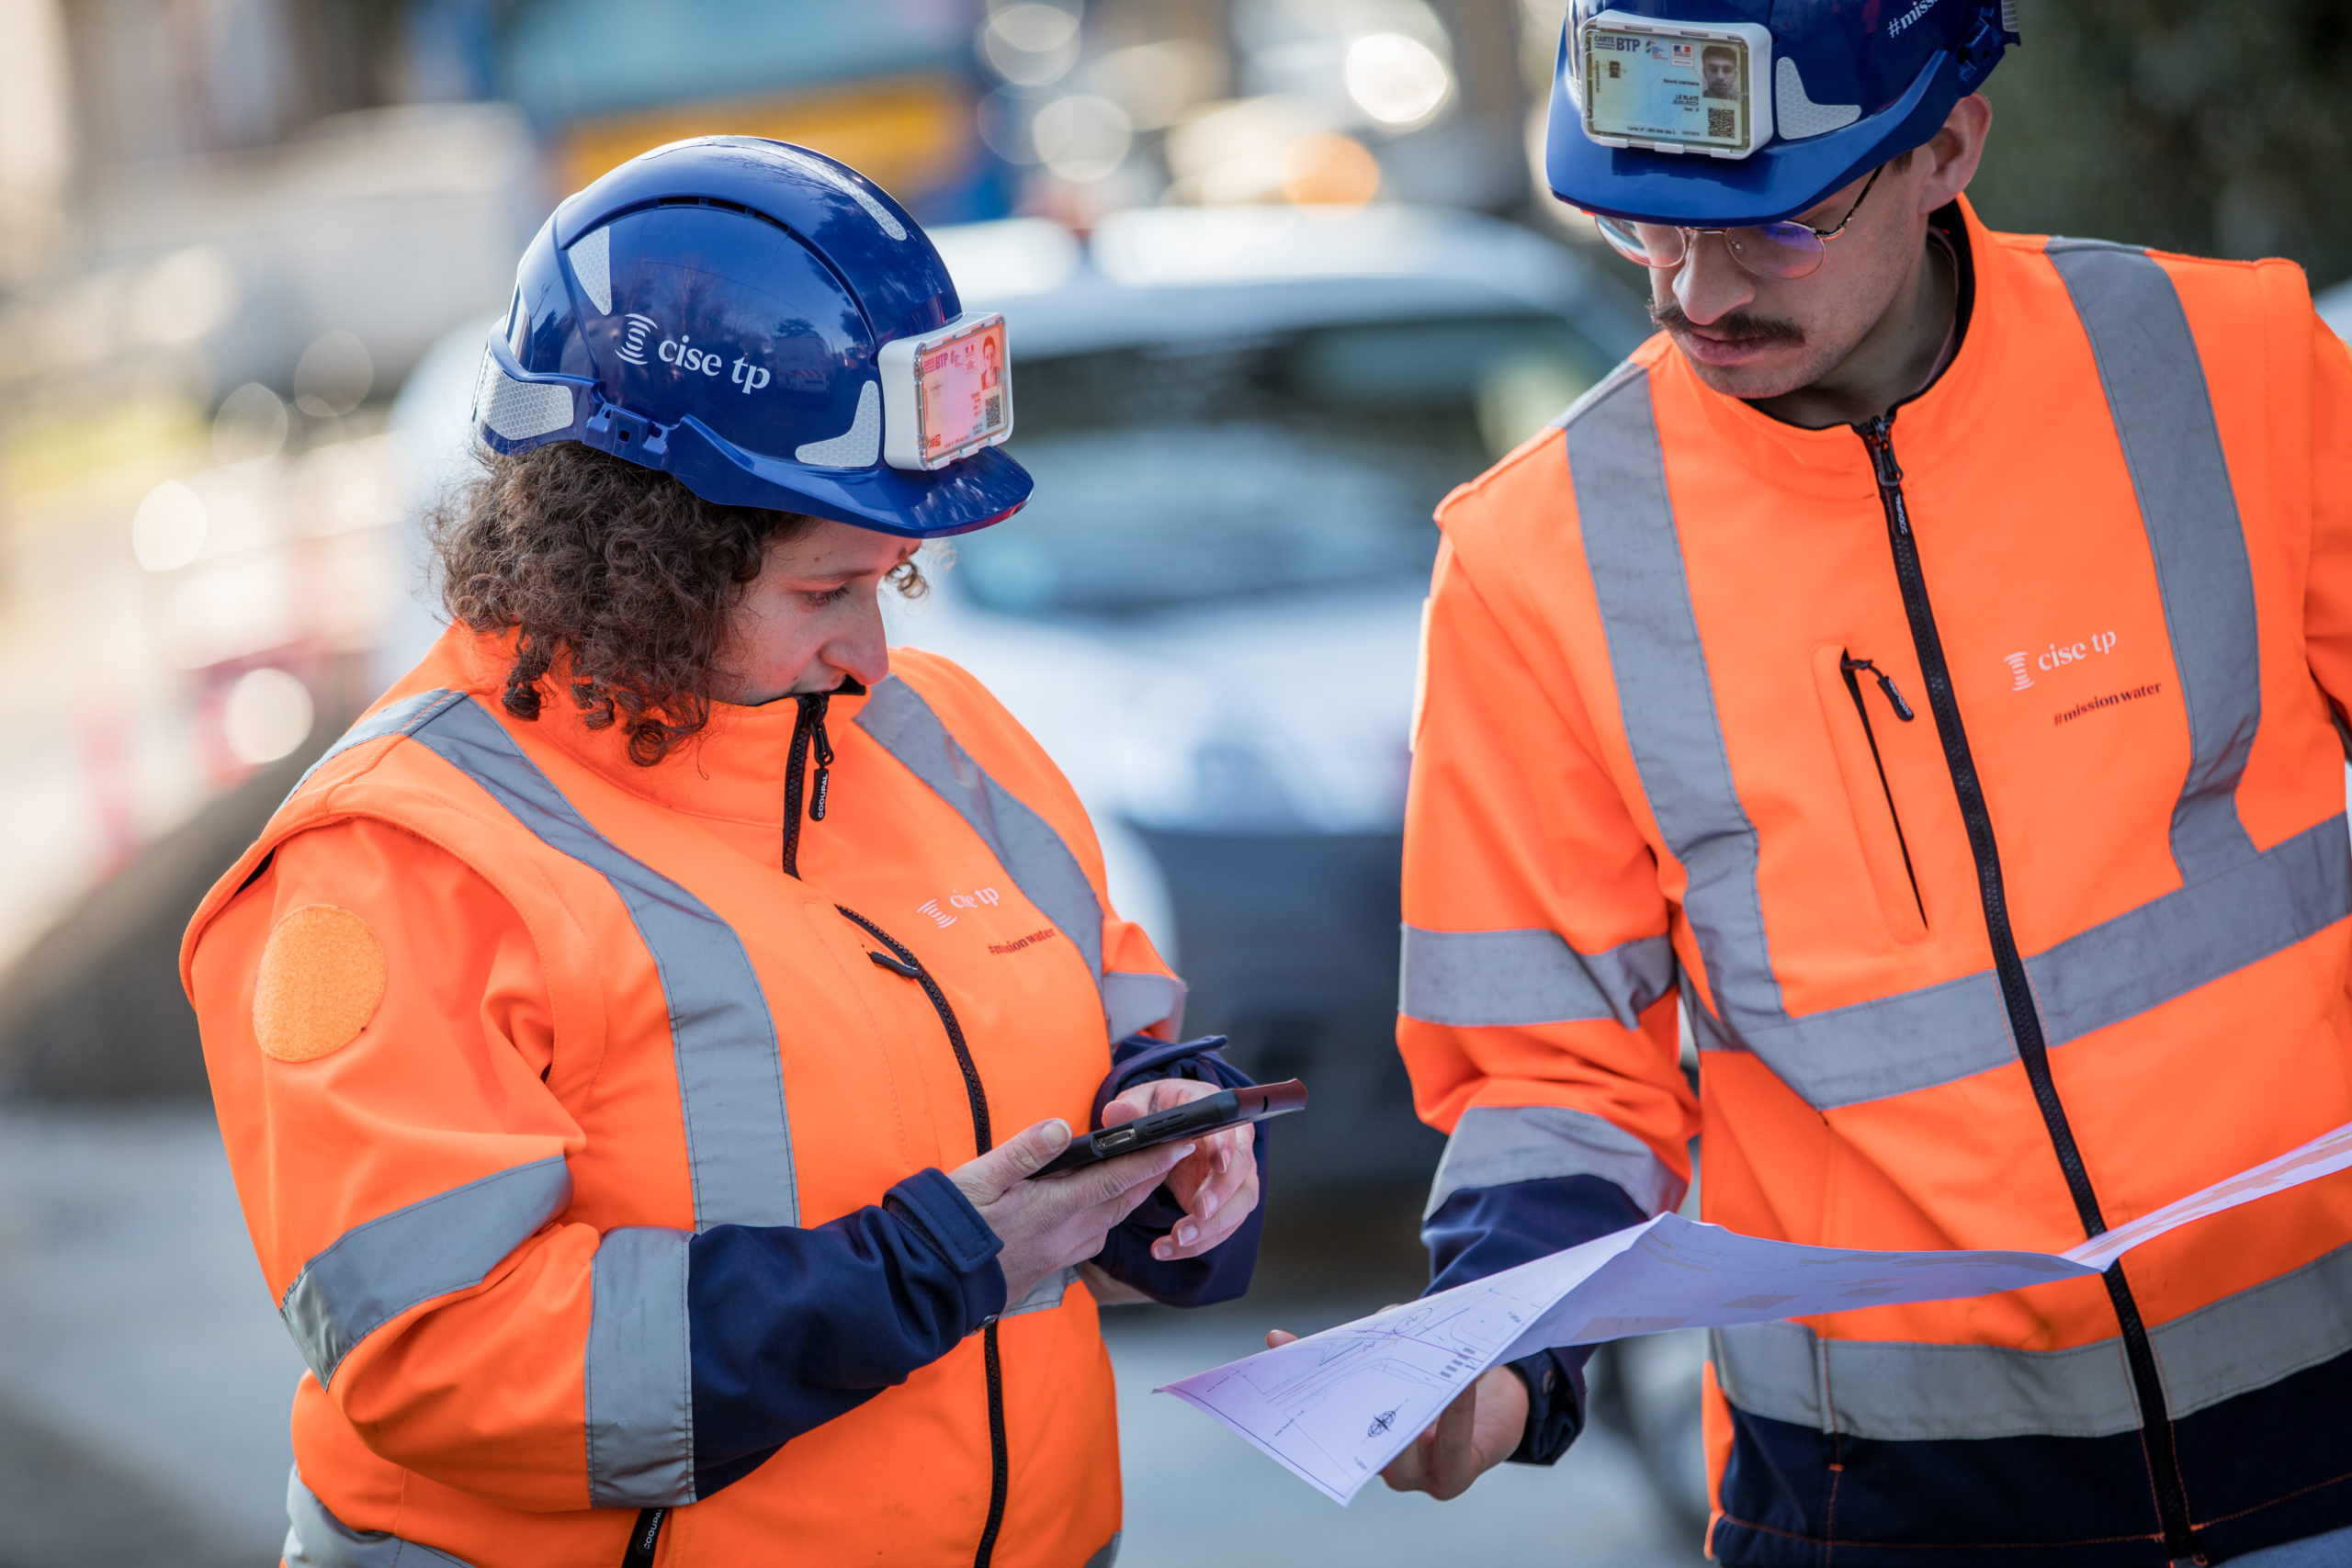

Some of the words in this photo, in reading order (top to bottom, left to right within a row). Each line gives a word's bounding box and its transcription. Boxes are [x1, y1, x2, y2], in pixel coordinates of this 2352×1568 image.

[1887, 0, 1937, 39] #miss
[1594, 35, 1616, 43] CARTE
[1616, 38, 1641, 52] BTP
[658, 334, 722, 377] cise
[731, 356, 771, 395] tp
[935, 352, 949, 369] BTP
[2038, 643, 2086, 671] cise
[2091, 630, 2117, 654] tp
[818, 773, 829, 818] CODUPAL
[974, 886, 1001, 908] tp
